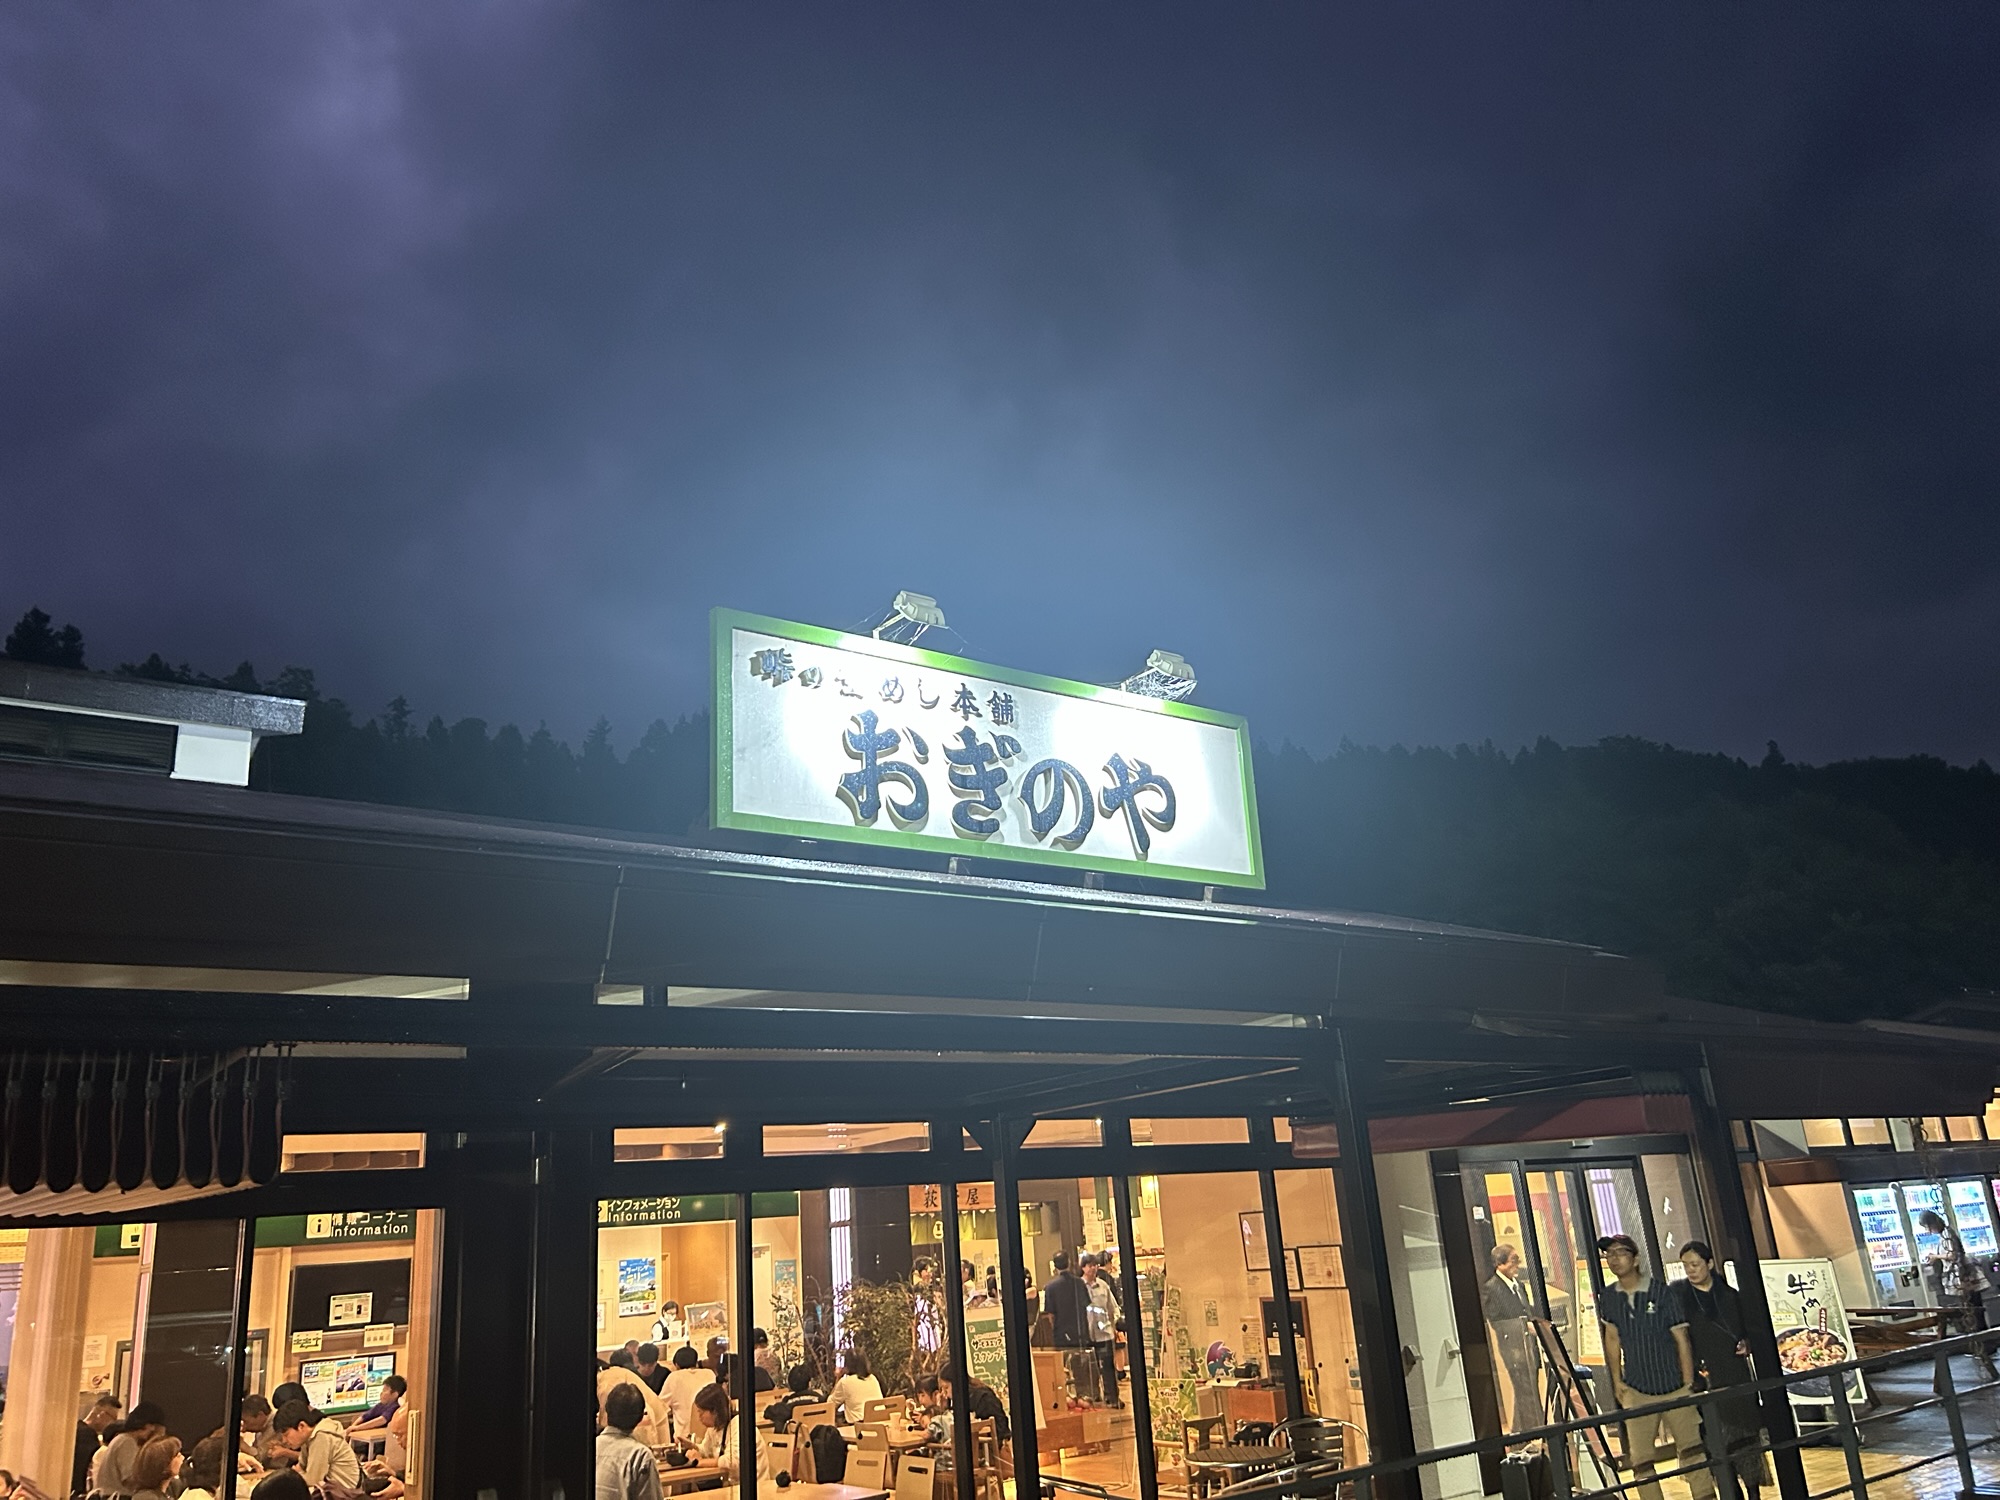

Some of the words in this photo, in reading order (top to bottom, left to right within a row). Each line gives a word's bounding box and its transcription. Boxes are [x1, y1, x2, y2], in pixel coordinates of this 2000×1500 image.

[835, 709, 1176, 861] おぎのや
[608, 1197, 681, 1211] インフォメーション
[924, 1188, 980, 1208] 荻屋
[332, 1210, 409, 1226] 情報コーナー
[608, 1209, 681, 1222] Information
[331, 1224, 408, 1237] Information
